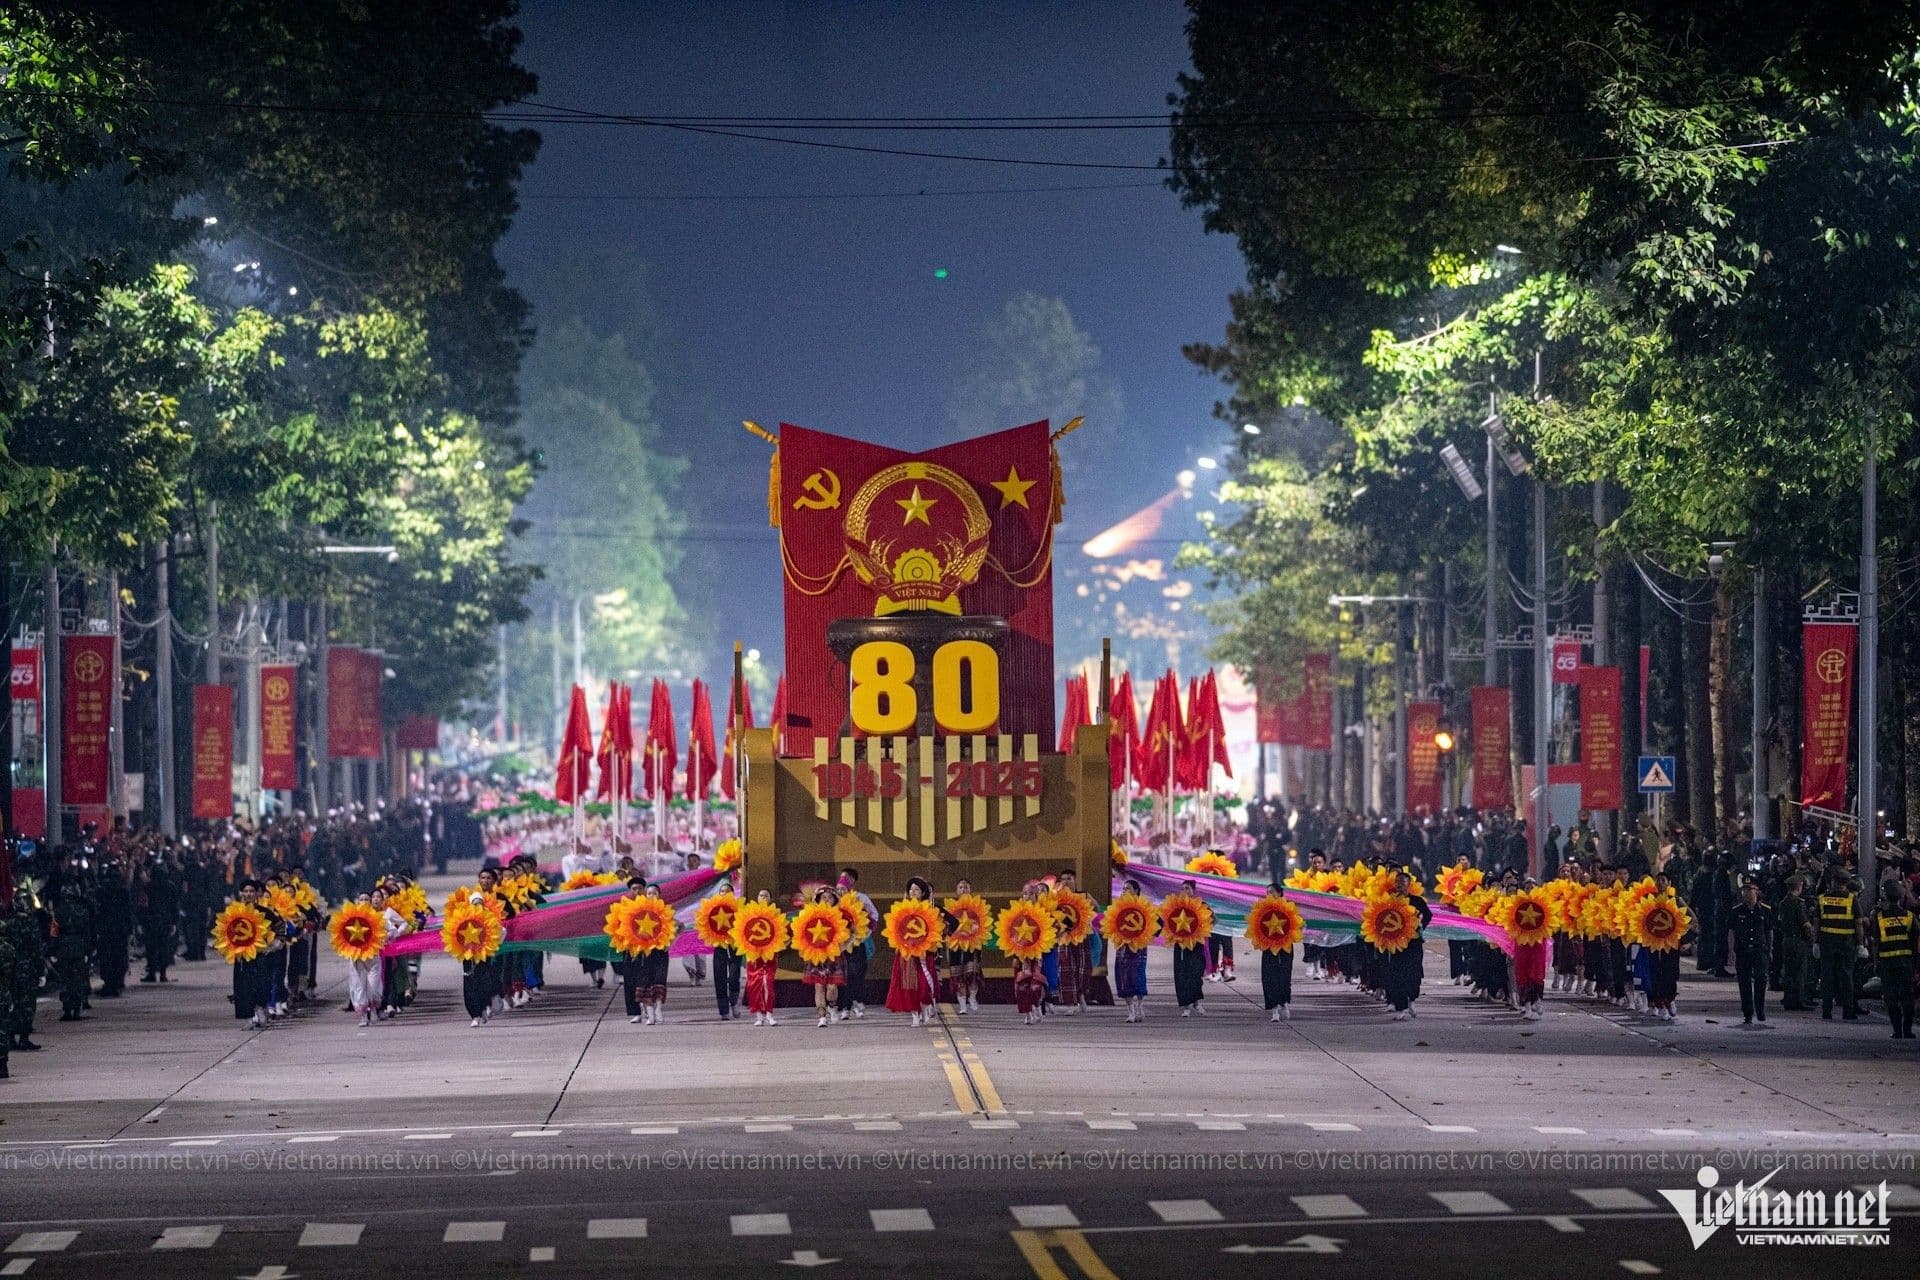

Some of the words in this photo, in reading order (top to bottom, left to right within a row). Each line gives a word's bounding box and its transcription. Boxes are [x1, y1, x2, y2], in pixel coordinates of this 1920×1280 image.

[851, 640, 999, 734] 80
[812, 758, 901, 799] 1945
[945, 761, 1043, 797] 2025
